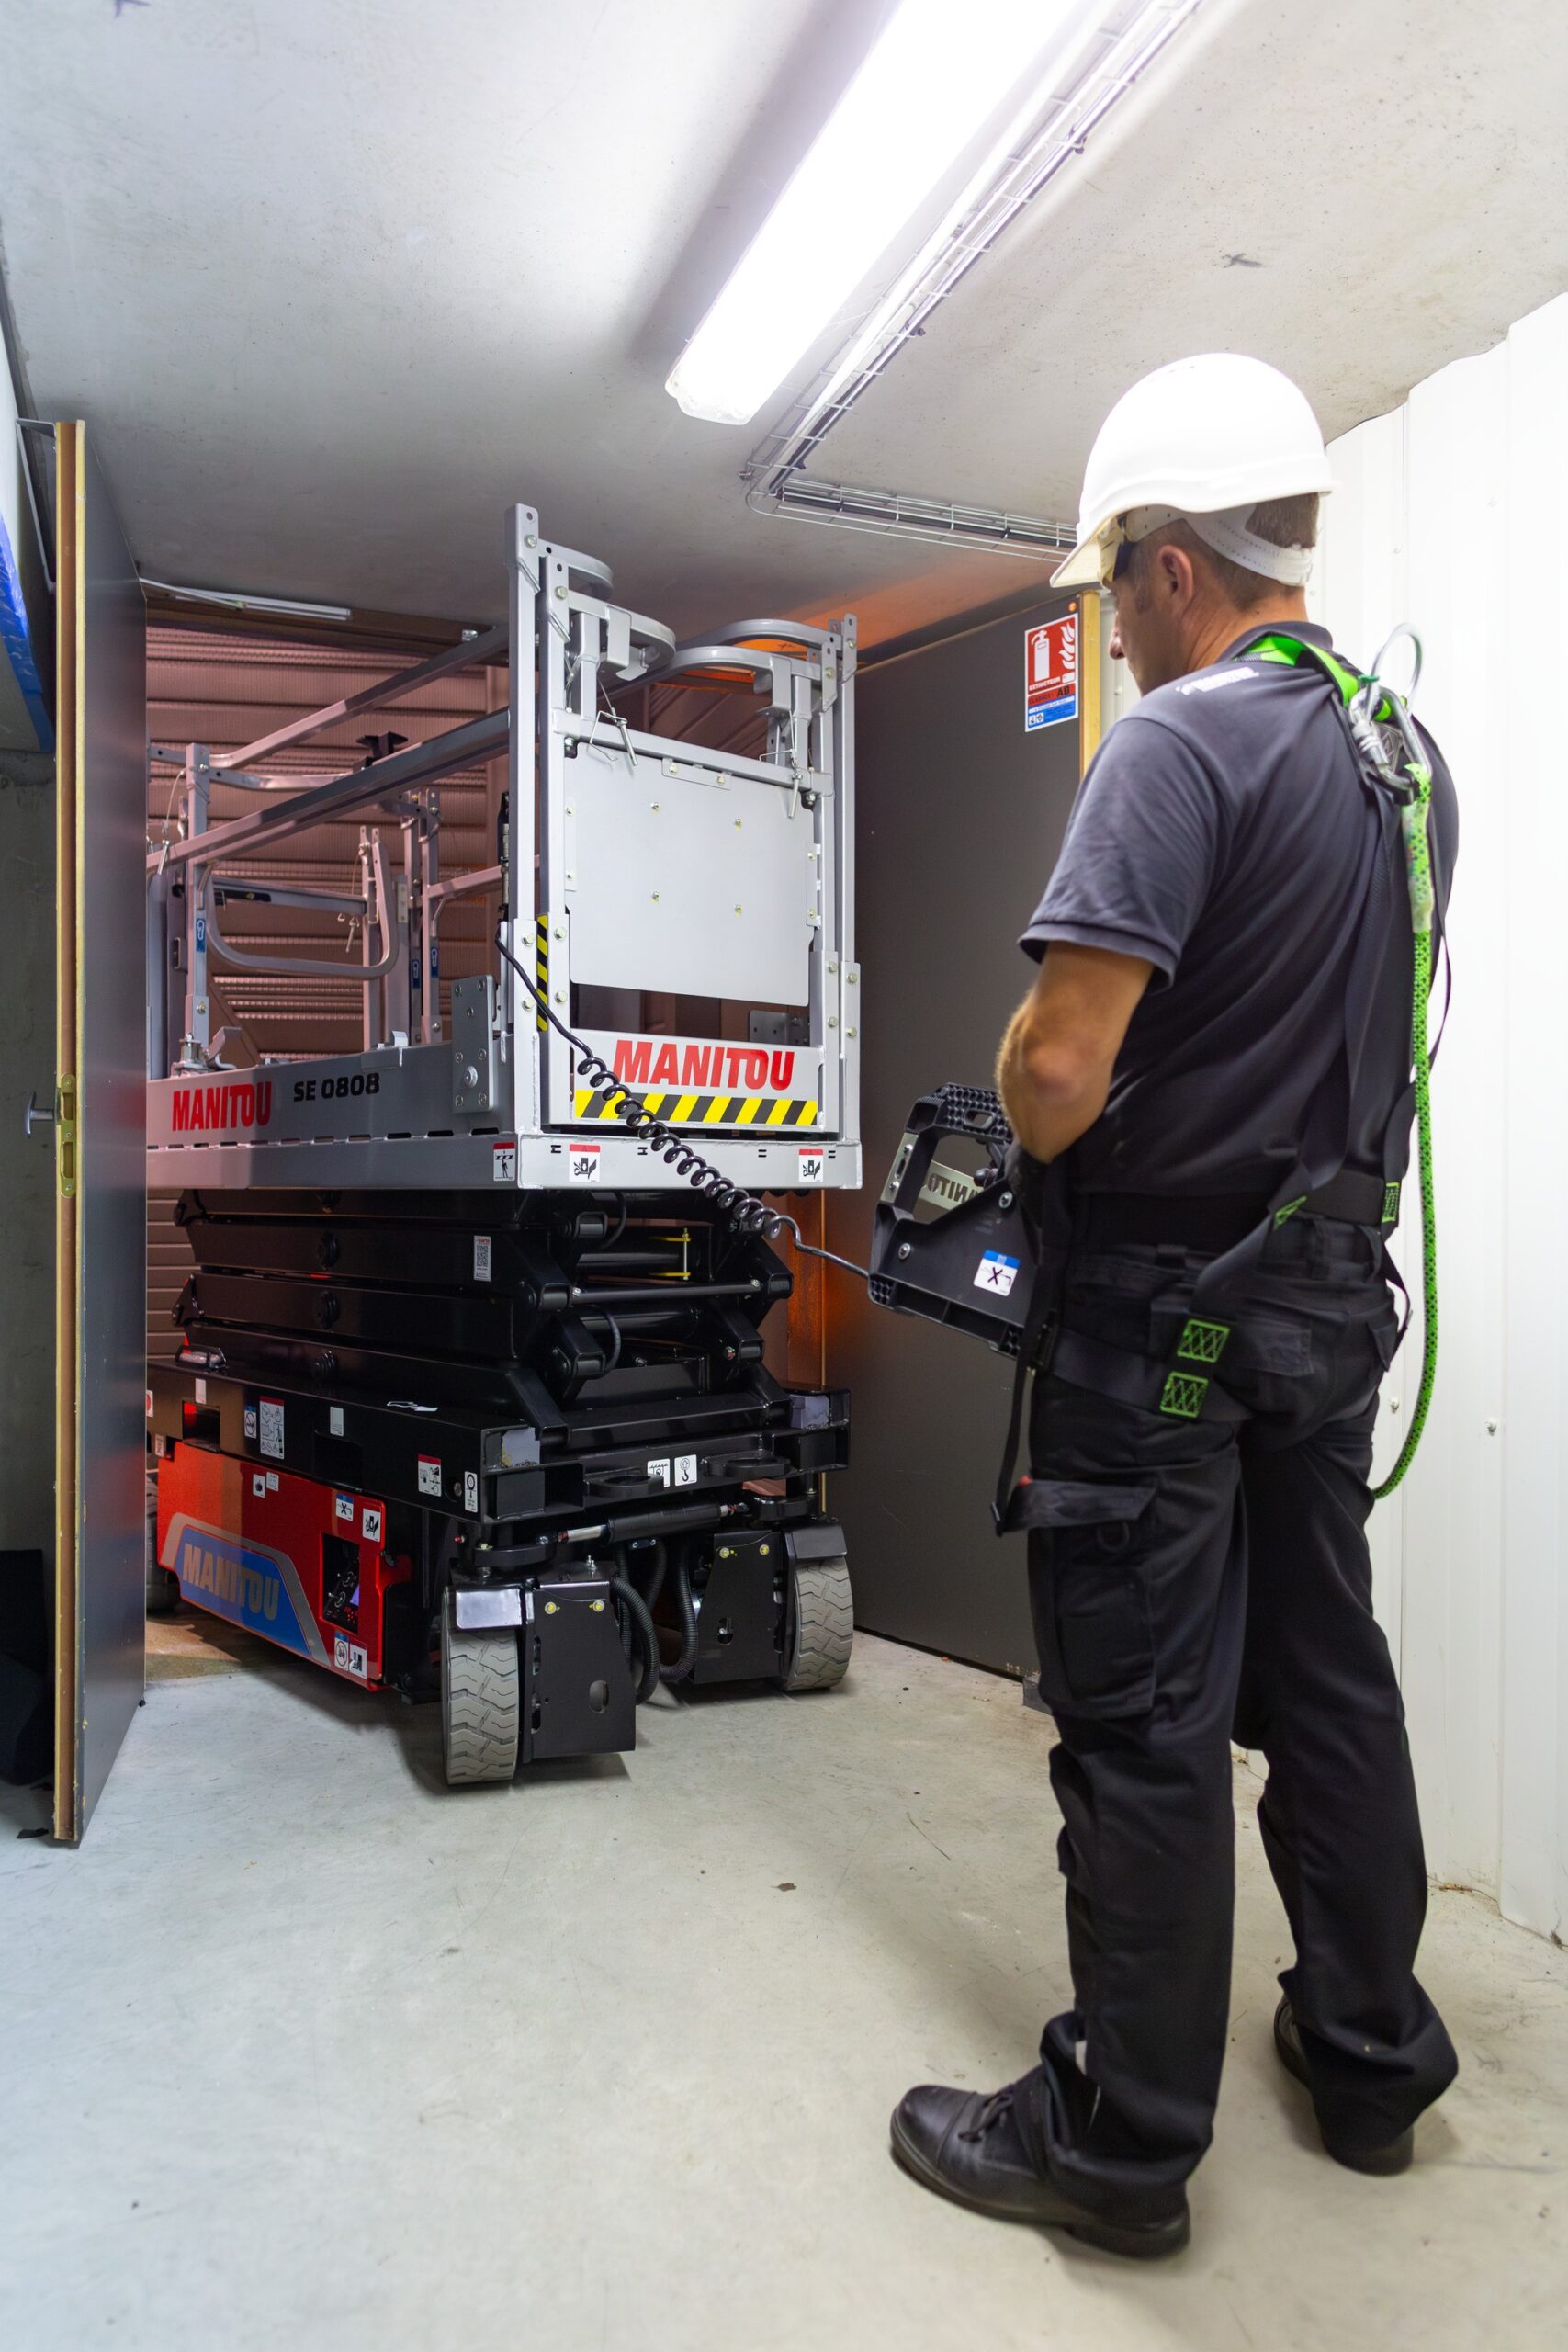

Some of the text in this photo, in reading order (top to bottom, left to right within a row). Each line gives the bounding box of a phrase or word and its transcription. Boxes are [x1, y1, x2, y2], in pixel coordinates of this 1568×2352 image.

[1057, 685, 1070, 698] AB
[293, 1072, 380, 1102] SE 0808
[613, 1039, 795, 1091] MANITOU
[172, 1080, 272, 1131] MANITOU
[183, 1543, 279, 1621] MANITOU
